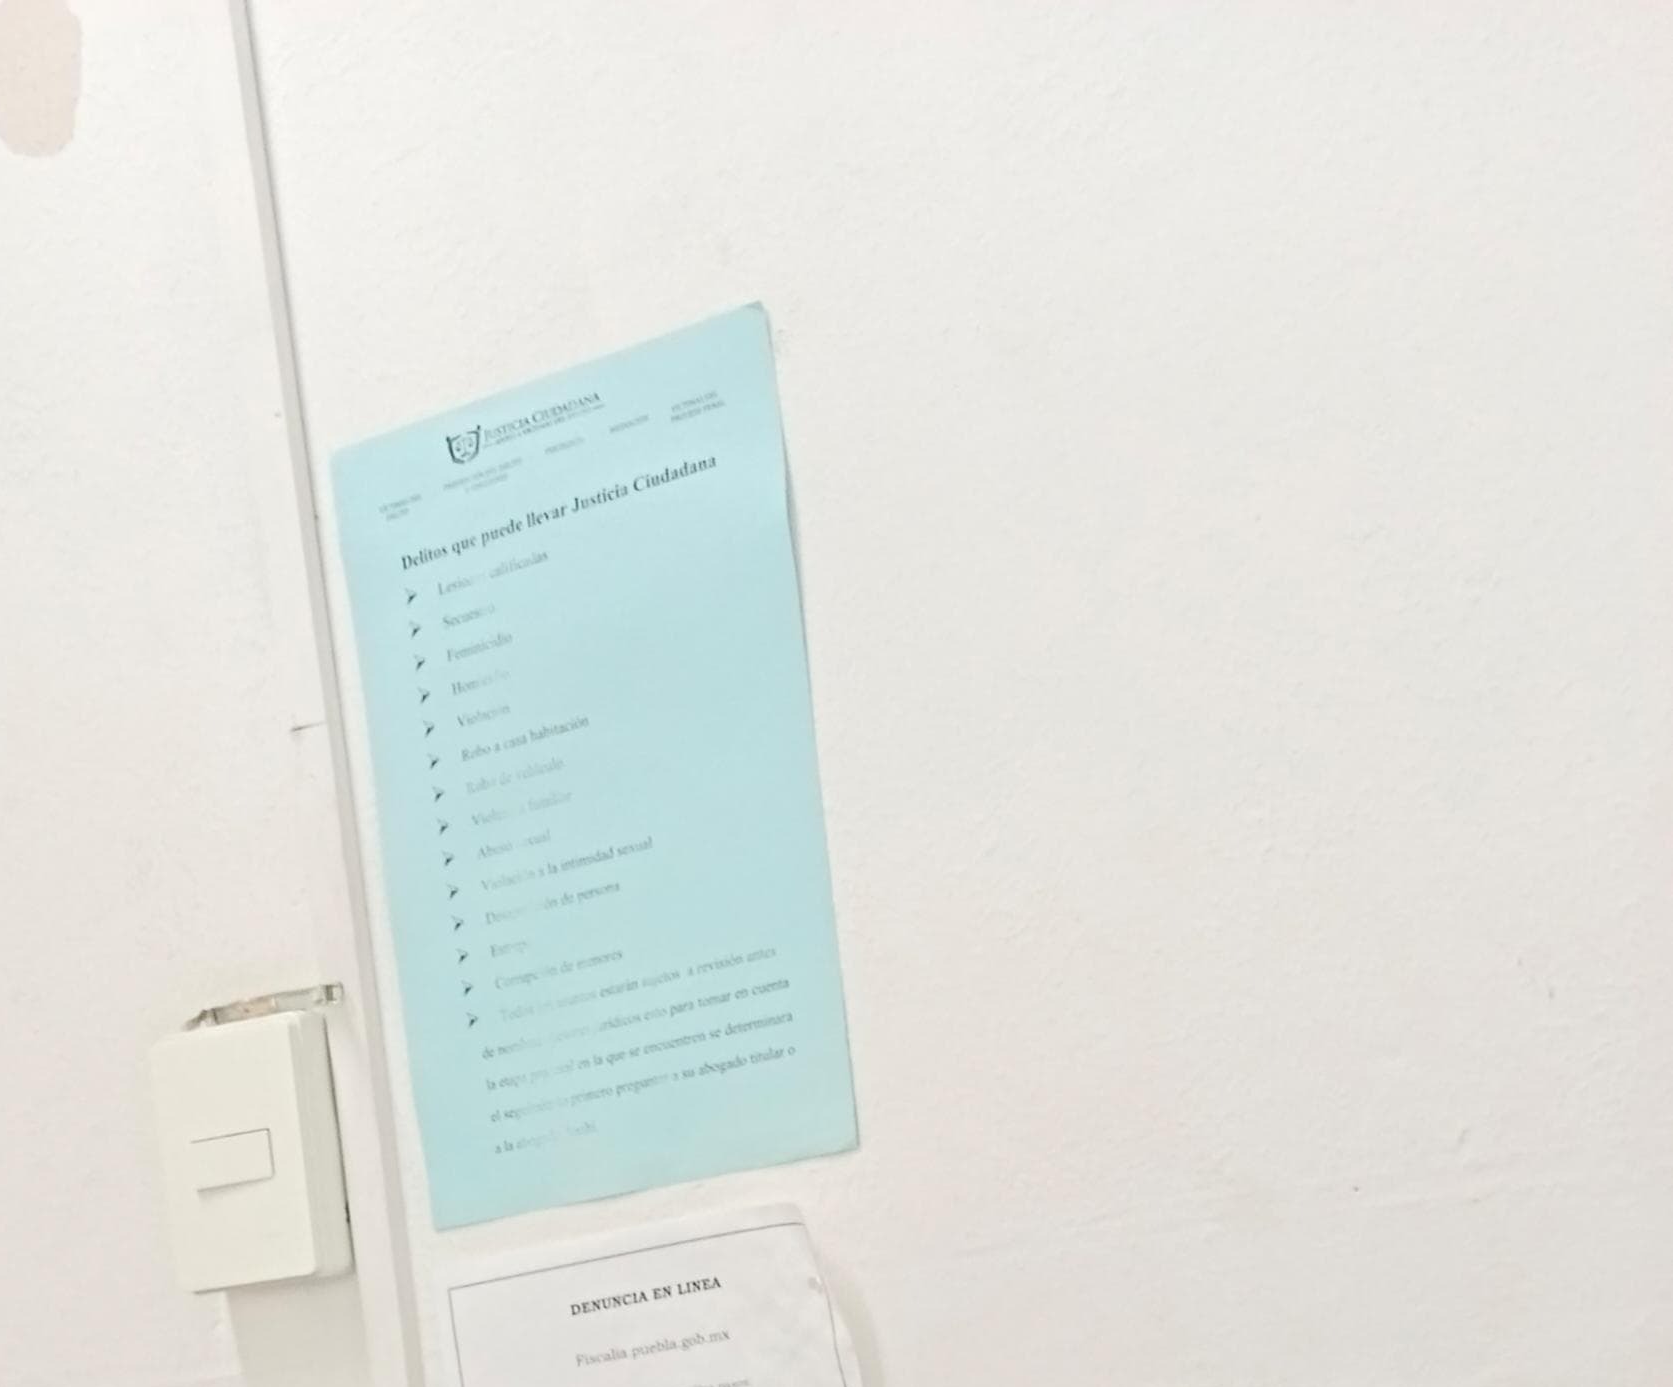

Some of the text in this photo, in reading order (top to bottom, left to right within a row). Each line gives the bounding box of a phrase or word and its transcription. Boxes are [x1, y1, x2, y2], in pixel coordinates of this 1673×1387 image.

[401, 453, 716, 569] Delitos que puede llevar Justicia Ciudadana
[457, 702, 510, 727] Violacin
[570, 1276, 721, 1315] DENUNCIA EN LINEA
